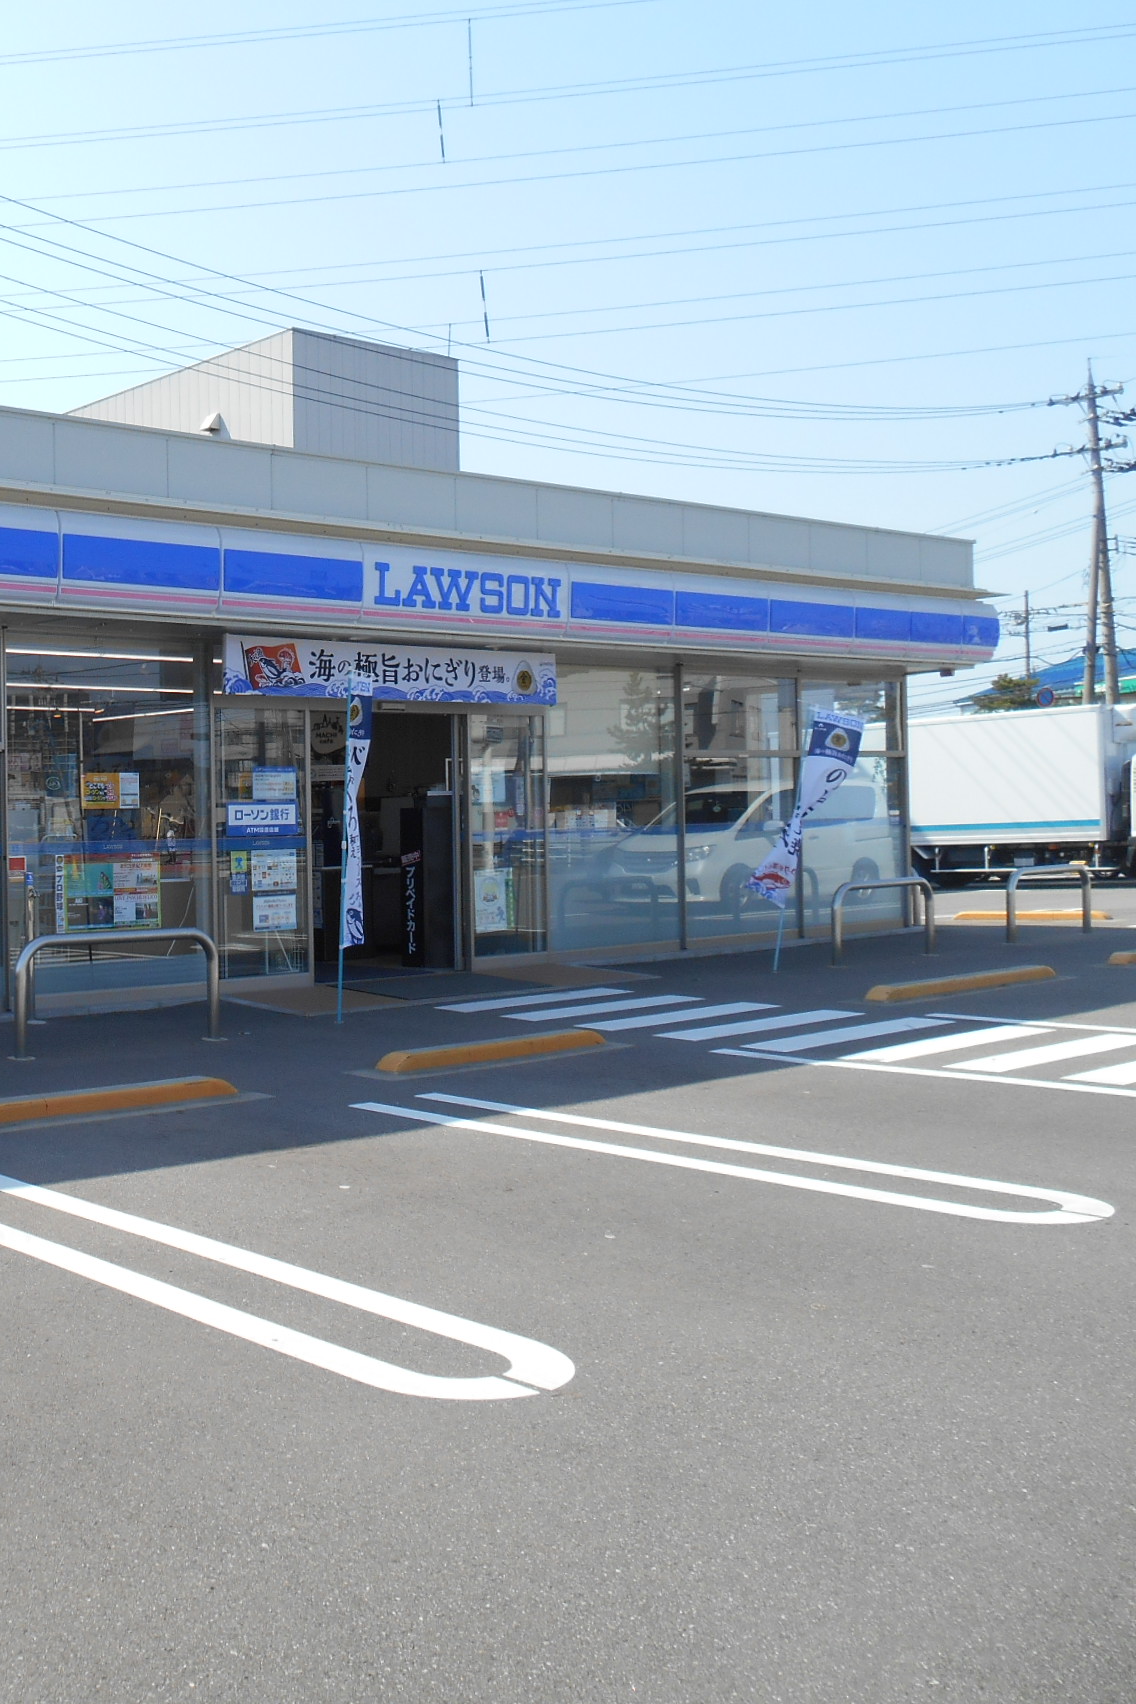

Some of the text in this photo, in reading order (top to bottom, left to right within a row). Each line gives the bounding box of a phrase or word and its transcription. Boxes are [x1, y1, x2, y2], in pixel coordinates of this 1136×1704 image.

[374, 561, 562, 618] LAWSON
[234, 808, 290, 821] ローソン銀行
[405, 866, 416, 954] プリペイドカード
